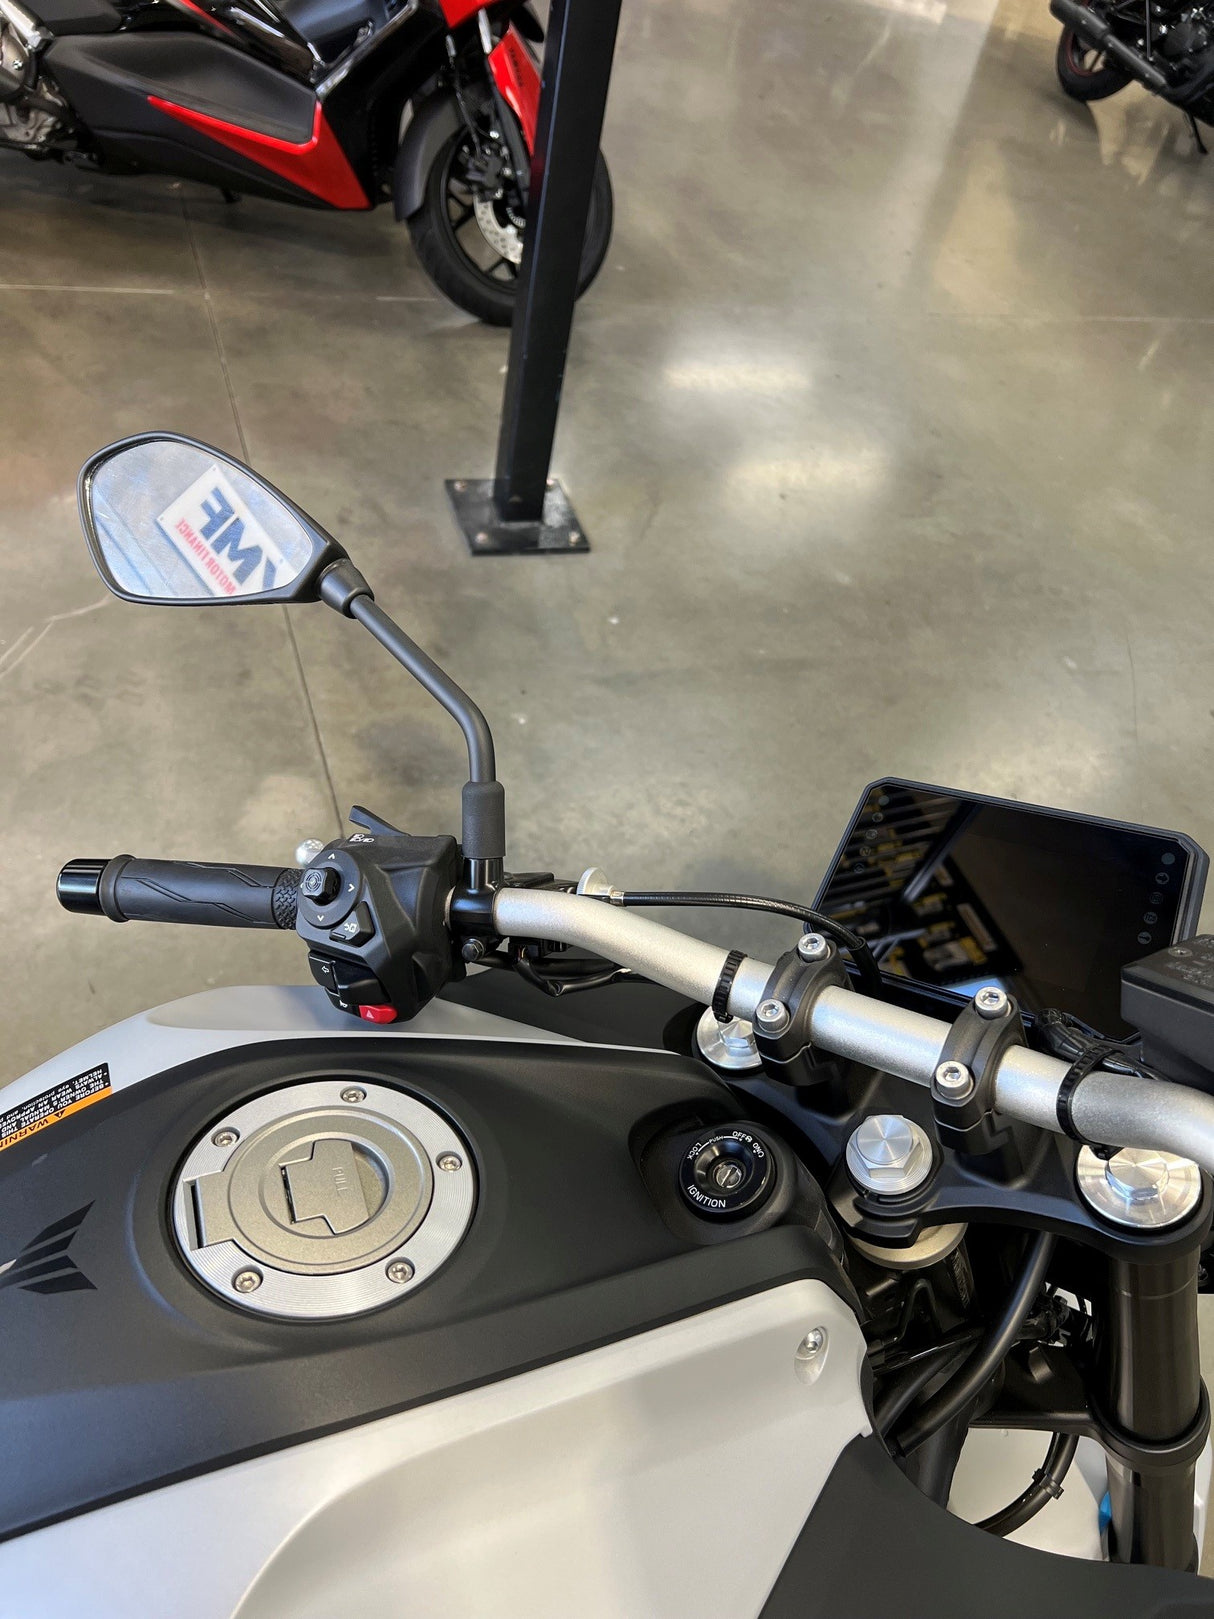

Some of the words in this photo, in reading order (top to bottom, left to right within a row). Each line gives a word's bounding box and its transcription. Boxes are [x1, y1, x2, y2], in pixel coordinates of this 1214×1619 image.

[75, 1073, 103, 1090] ALWAYS
[89, 1079, 104, 1089] THE
[51, 1088, 72, 1101] WEAR
[53, 1087, 87, 1106] OWNER'S
[75, 1083, 104, 1101] BEFORE
[38, 1099, 49, 1108] AN
[57, 1099, 72, 1109] YOU
[6, 1110, 19, 1119] and
[20, 1104, 50, 1122] MANUAL
[21, 1107, 55, 1127] OPERATE
[1, 1121, 17, 1133] AND
[1, 1126, 18, 1138] THIS
[709, 1136, 724, 1144] PUSH
[732, 1131, 747, 1139] OFF
[687, 1142, 702, 1160] LOCK
[687, 1184, 726, 1208] IGNITION
